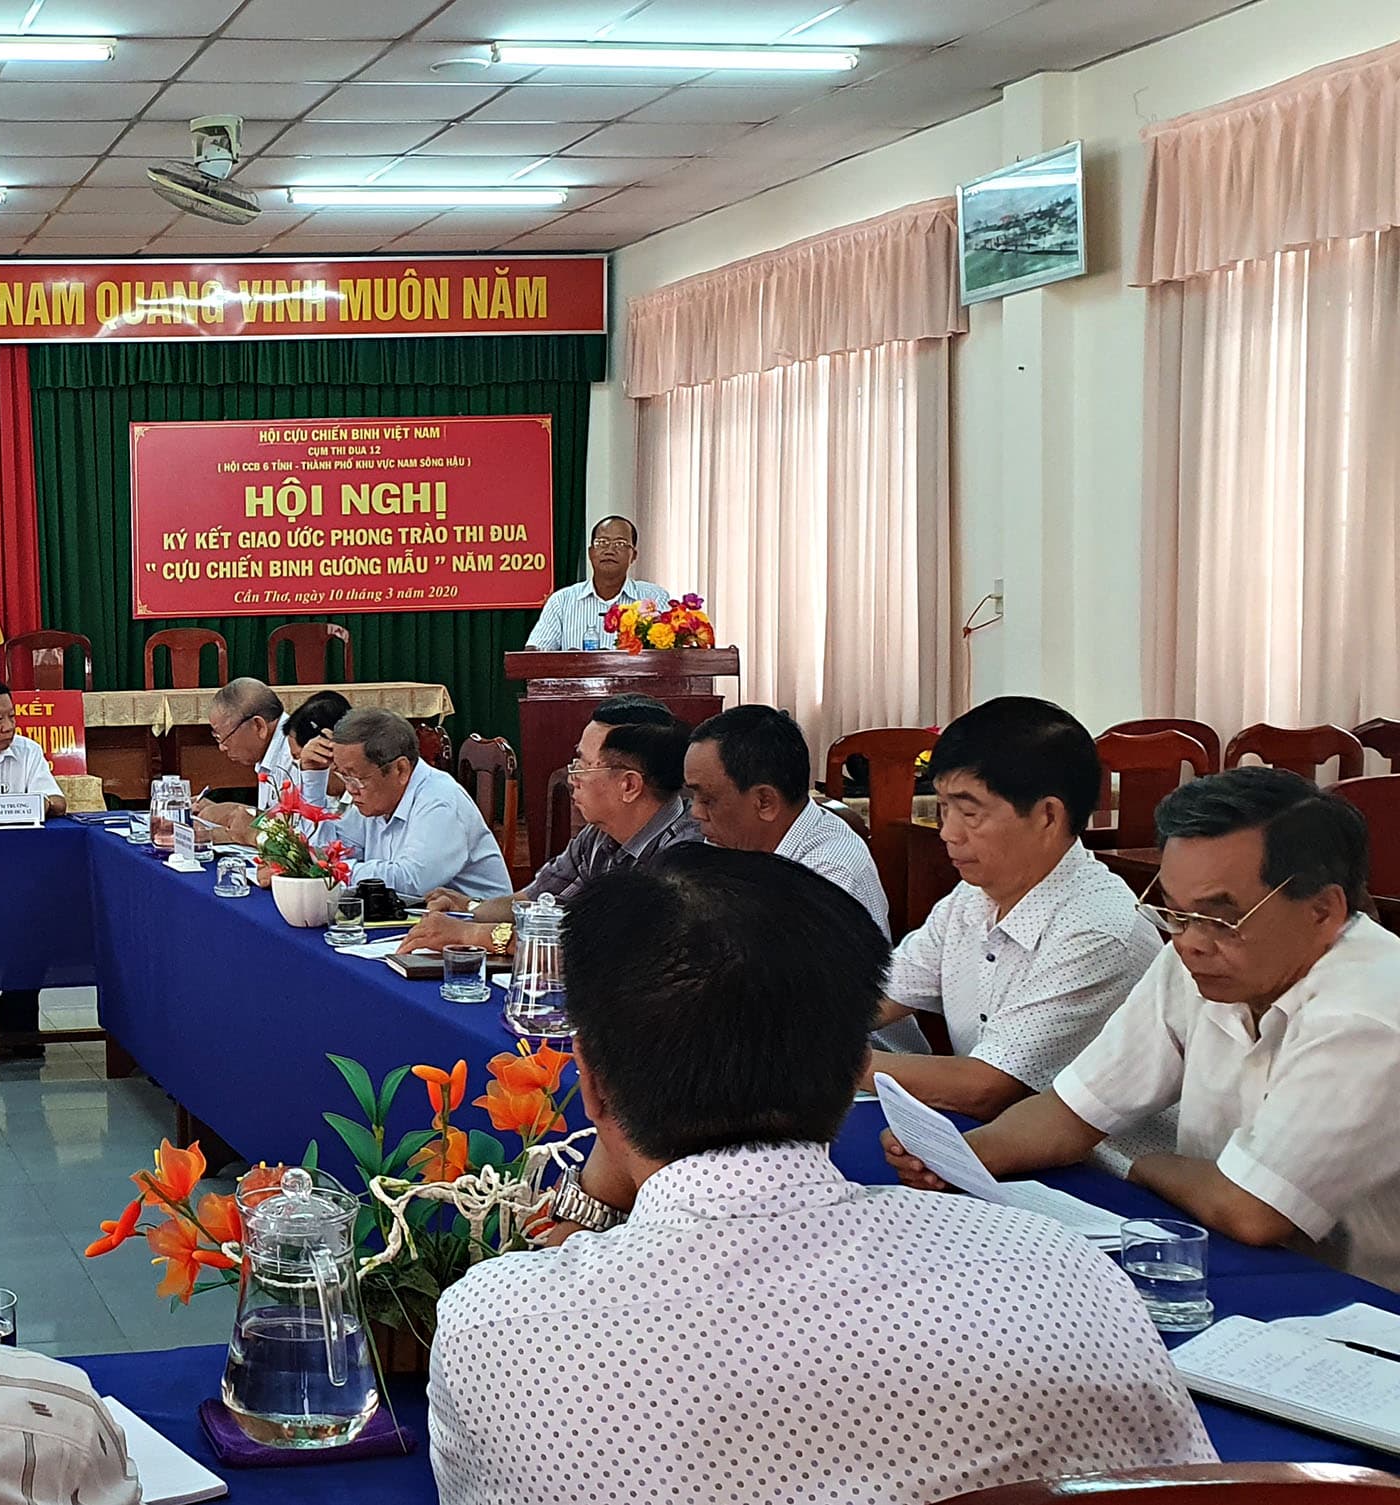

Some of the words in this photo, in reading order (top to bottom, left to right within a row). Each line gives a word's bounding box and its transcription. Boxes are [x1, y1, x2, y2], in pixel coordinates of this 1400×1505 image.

[96, 280, 223, 330] QUANG
[239, 279, 327, 323] VINH
[339, 268, 449, 322] MUÔN
[463, 266, 548, 320] NĂM
[259, 428, 280, 443] HỘI
[284, 428, 307, 444] CỰU
[312, 425, 348, 441] CHIẾN
[351, 428, 380, 440] BINH
[383, 427, 410, 441] VIỆT
[414, 427, 440, 438] NAM
[308, 447, 329, 458] CỤM
[331, 446, 346, 455] THI
[369, 446, 380, 455] 12
[223, 461, 240, 473] HỘI
[242, 462, 260, 471] CCB
[263, 462, 269, 471] 6
[301, 458, 331, 470] THÀNH
[334, 458, 353, 469] PHỐ
[356, 460, 374, 469] KHU
[377, 458, 395, 469] VỰC
[397, 459, 418, 468] NAM
[419, 457, 444, 467] SÔNG
[446, 457, 465, 468] HẬU
[244, 477, 323, 523] HỘI
[341, 482, 447, 520] NGHỊ
[163, 528, 188, 550] KÝ
[195, 525, 232, 549] KẾT
[238, 530, 281, 548] GIAO
[287, 526, 325, 548] ƯỚC
[331, 528, 393, 547] PHONG
[398, 523, 448, 545] TRÀO
[453, 525, 484, 543] THI
[490, 524, 528, 542] ĐUA
[163, 559, 200, 583] CỰU
[206, 554, 263, 579] CHIẾN
[269, 559, 313, 577] BINH
[320, 555, 382, 576] GƯƠNG
[387, 549, 429, 574] MẪU
[452, 551, 493, 572] NĂM
[500, 553, 546, 571] 2020
[234, 589, 259, 603] Cần
[264, 591, 291, 604] Thơ,
[295, 590, 325, 606] ngày
[329, 590, 343, 601] 10
[346, 587, 382, 602] tháng
[386, 587, 393, 599] 3
[397, 587, 424, 599] năm
[428, 585, 458, 598] 2020
[15, 697, 54, 715] KẾT
[50, 726, 76, 753] ĐUA
